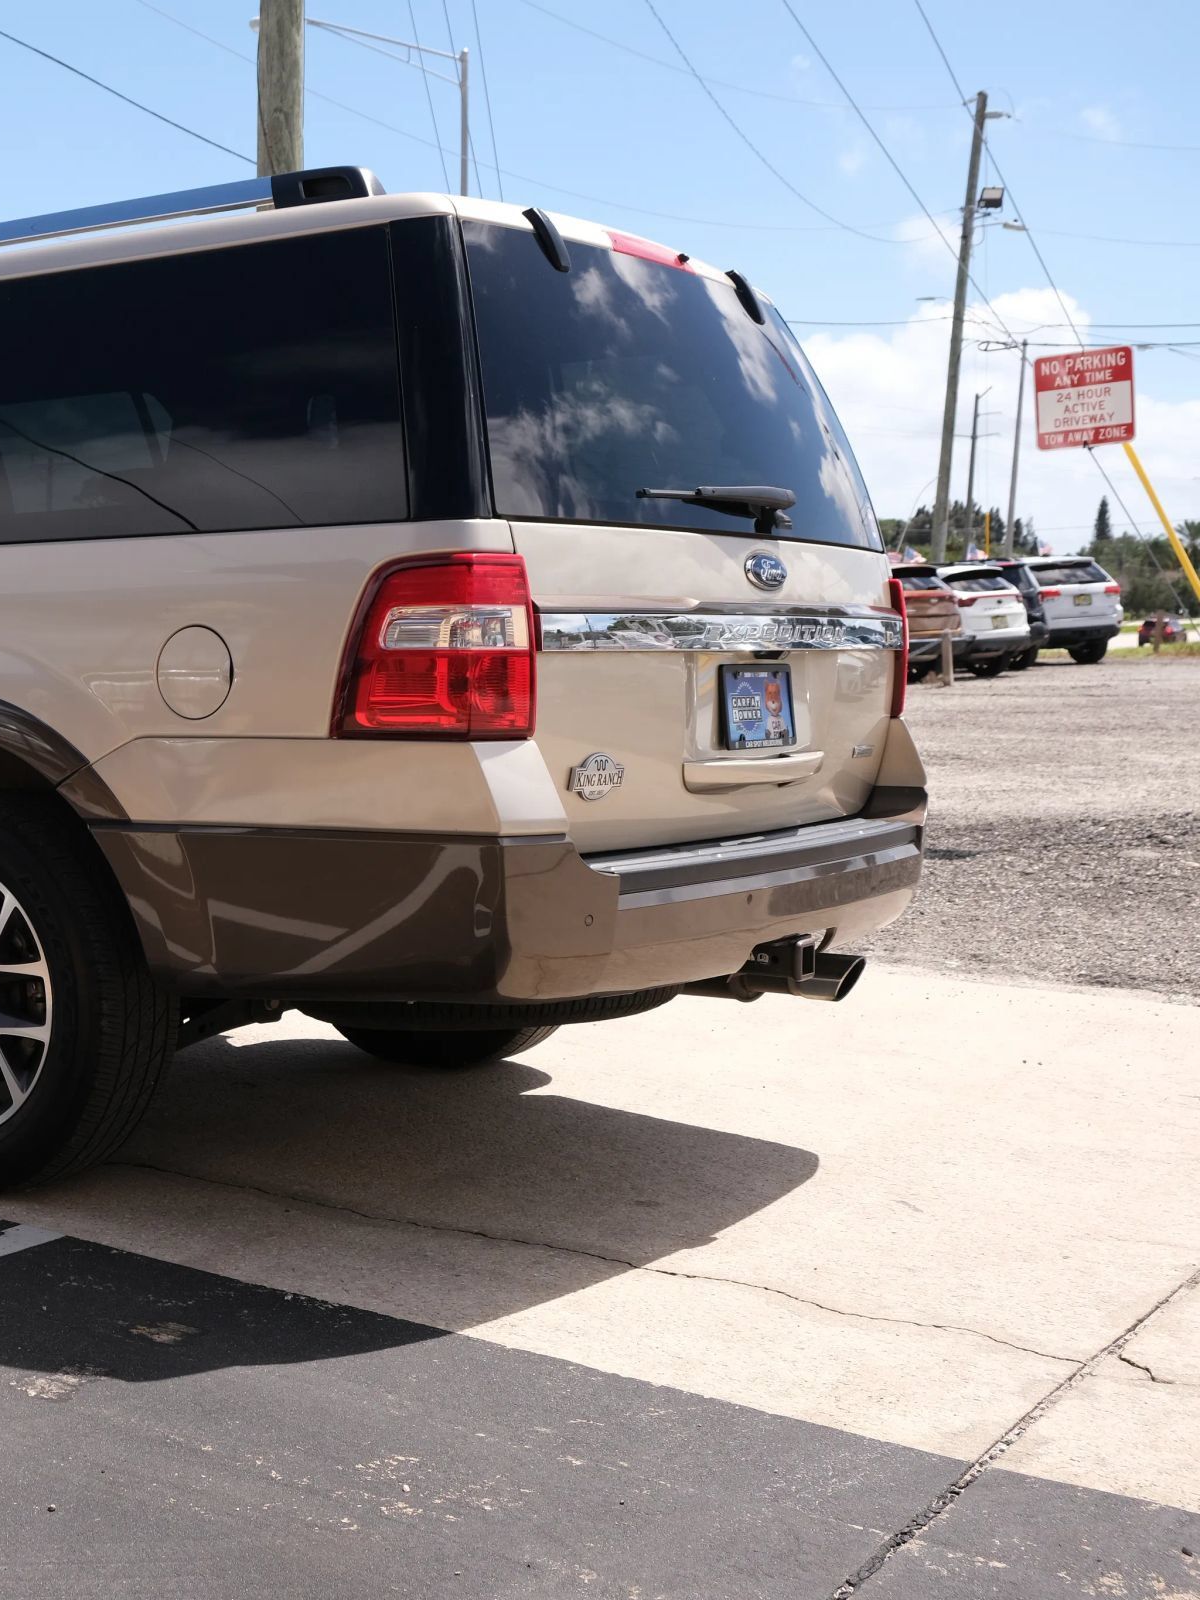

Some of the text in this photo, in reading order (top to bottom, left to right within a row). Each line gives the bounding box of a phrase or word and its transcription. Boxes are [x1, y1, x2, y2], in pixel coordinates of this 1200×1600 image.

[1041, 352, 1126, 376] NO PARKING
[1054, 370, 1112, 387] ANY TIME
[1056, 387, 1111, 403] 24 HOUR
[1064, 401, 1105, 414] ACTIVE
[1054, 412, 1114, 428] DRIVEWAY
[1044, 425, 1128, 445] TOW AWAY ZONE
[760, 558, 783, 580] Ford
[703, 624, 846, 642] EXPEDITION
[576, 770, 623, 787] KING RANCH
